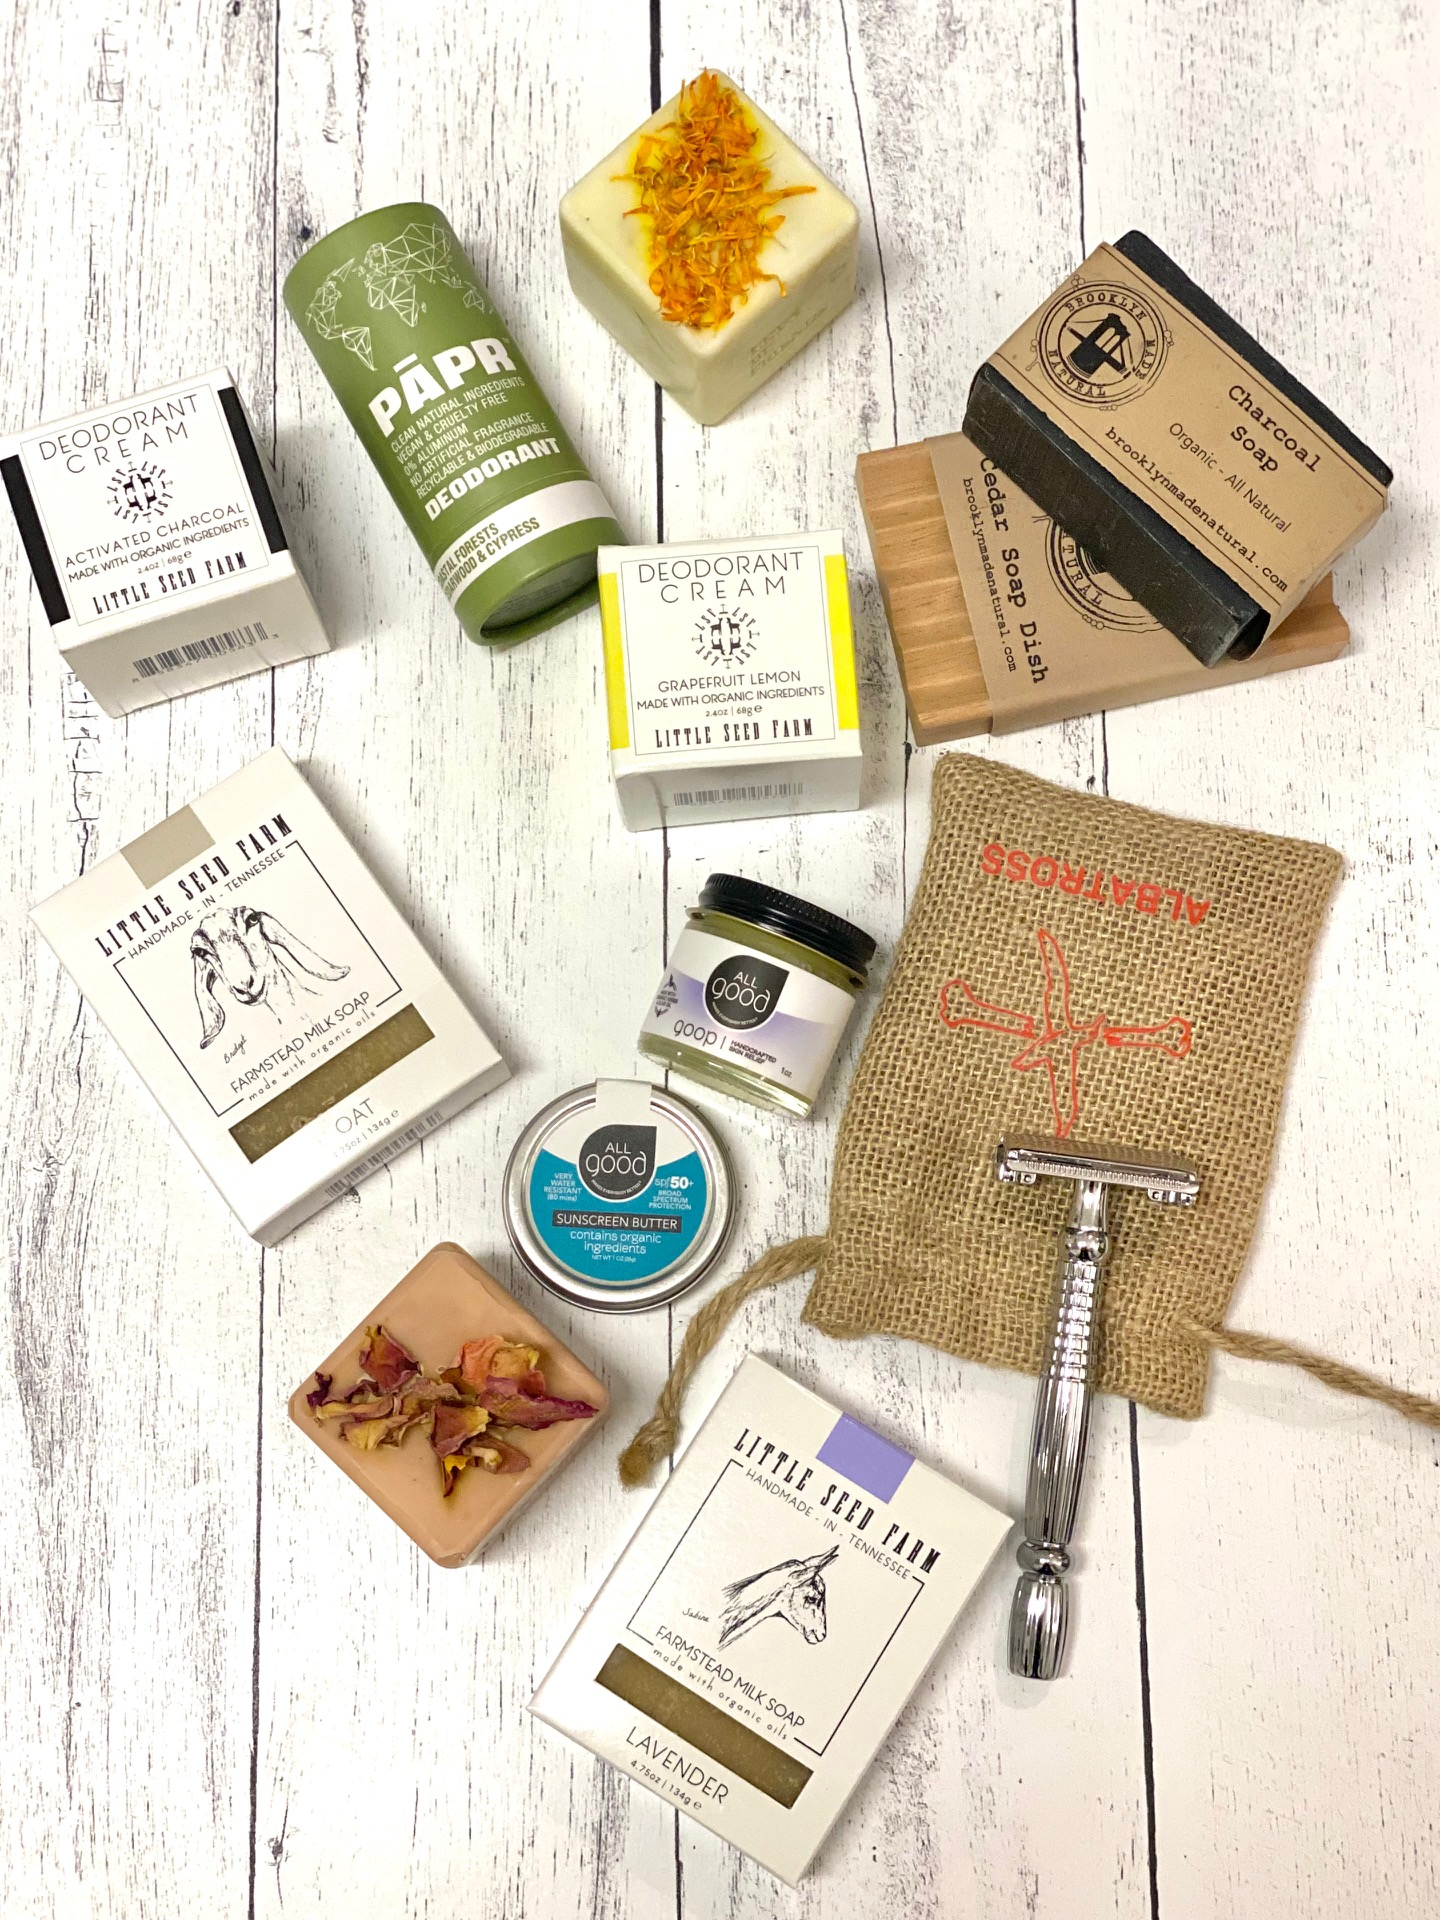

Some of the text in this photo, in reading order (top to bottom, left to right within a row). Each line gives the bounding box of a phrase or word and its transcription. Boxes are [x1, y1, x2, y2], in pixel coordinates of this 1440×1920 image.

[1048, 292, 1155, 396] BROOKLYN MADE NATURAL
[39, 393, 196, 460] DEODORANT
[391, 377, 525, 453] CLEAN NATURAL INGREDIENTS
[397, 393, 508, 464] VEGAN & CRUELTY FREE
[1228, 385, 1320, 472] Charcoal
[66, 422, 187, 473] CREAM
[404, 423, 469, 476] 0% ALUMINUM
[410, 412, 534, 488] NO ARTIFICIAL FRAGRANCE
[417, 423, 549, 499] RECYCLABLE & BIODEGRADABLE
[1169, 422, 1217, 469] Organic
[1224, 474, 1246, 492] All
[1242, 488, 1291, 532] Natural
[1230, 426, 1277, 471] Soap
[425, 438, 560, 521] DEODORANT
[1105, 426, 1287, 591] brooklynmadenatural.com
[66, 503, 243, 567] ACTIVATED CHARCOAL
[68, 517, 248, 582] MADE WITH ORGANIC INGREDIENTS
[454, 523, 499, 563] FORESTS
[476, 550, 487, 562] &
[485, 517, 540, 556] CYPRESS
[92, 552, 246, 614] LITTLE SEED FARM
[638, 551, 802, 582] DEODORANT
[660, 575, 784, 603] CREAM
[962, 477, 1016, 672] brooklynmadenatural.com
[980, 458, 1048, 683] Cedar Soap Dish
[637, 685, 824, 709] MADE WITH ORGANIC INGREDIENTS
[658, 670, 800, 692] GRAPEFRUIT LEMON
[655, 718, 812, 747] LITTLE SEED FARM
[95, 814, 291, 956] LITTLE SEED FARM
[128, 910, 193, 958] HANDMADE
[202, 895, 215, 907] IN
[224, 848, 284, 891] TENNESSEE
[981, 844, 1211, 926] ALBATROSS
[712, 978, 770, 1013] good
[734, 972, 757, 988] ALL
[230, 991, 368, 1092] FARMSTEAD MILK SOAP
[248, 1011, 375, 1100] made with organic oils
[674, 1020, 717, 1046] goop
[729, 1047, 765, 1064] SKIN RELIEF
[731, 1040, 776, 1063] HANDCRAFTED
[336, 1097, 373, 1132] OAT
[367, 1117, 391, 1135] 134g
[586, 1151, 646, 1177] good
[605, 1142, 631, 1154] ALL
[544, 1186, 582, 1194] RESISTANT
[557, 1213, 677, 1229] SUNSCREEN BUTTER
[570, 1230, 661, 1244] contains organic
[584, 1241, 646, 1254] ingredients
[733, 1430, 940, 1573] LITTLE SEED FARM
[745, 1468, 813, 1516] HANDMADE
[823, 1518, 837, 1532] IN
[849, 1533, 910, 1579] TENNESSEE
[653, 1649, 786, 1739] made with organic oils
[656, 1625, 804, 1726] FARMSTEAD MILK SOAP
[626, 1726, 728, 1803] LAVENDER
[630, 1760, 660, 1783] 4.75oz
[669, 1784, 691, 1805] 134g
